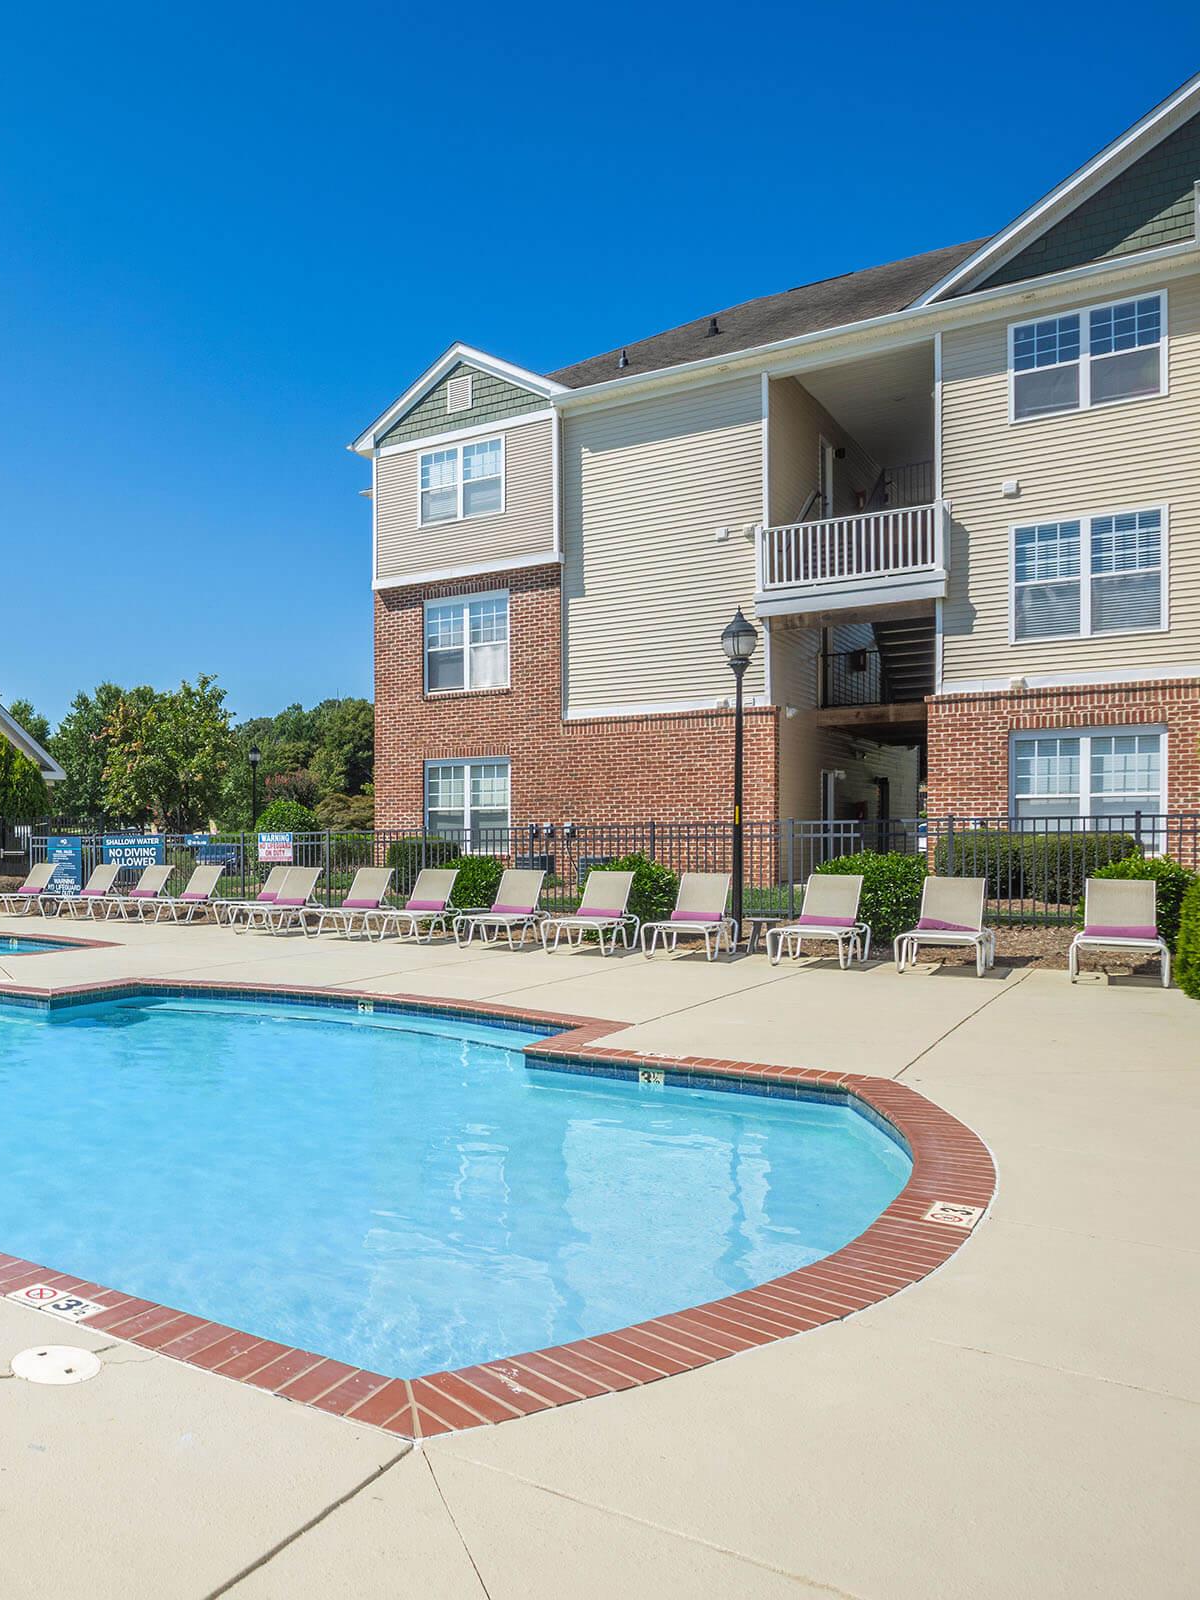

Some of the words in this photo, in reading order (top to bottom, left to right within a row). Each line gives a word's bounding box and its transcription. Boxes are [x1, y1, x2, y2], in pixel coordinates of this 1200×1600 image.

[106, 838, 135, 846] SHALLOW
[137, 837, 160, 845] WATER
[262, 834, 289, 842] WARNING
[109, 848, 123, 857] NO
[124, 847, 157, 857] DIVING
[111, 857, 156, 866] ALLOWED
